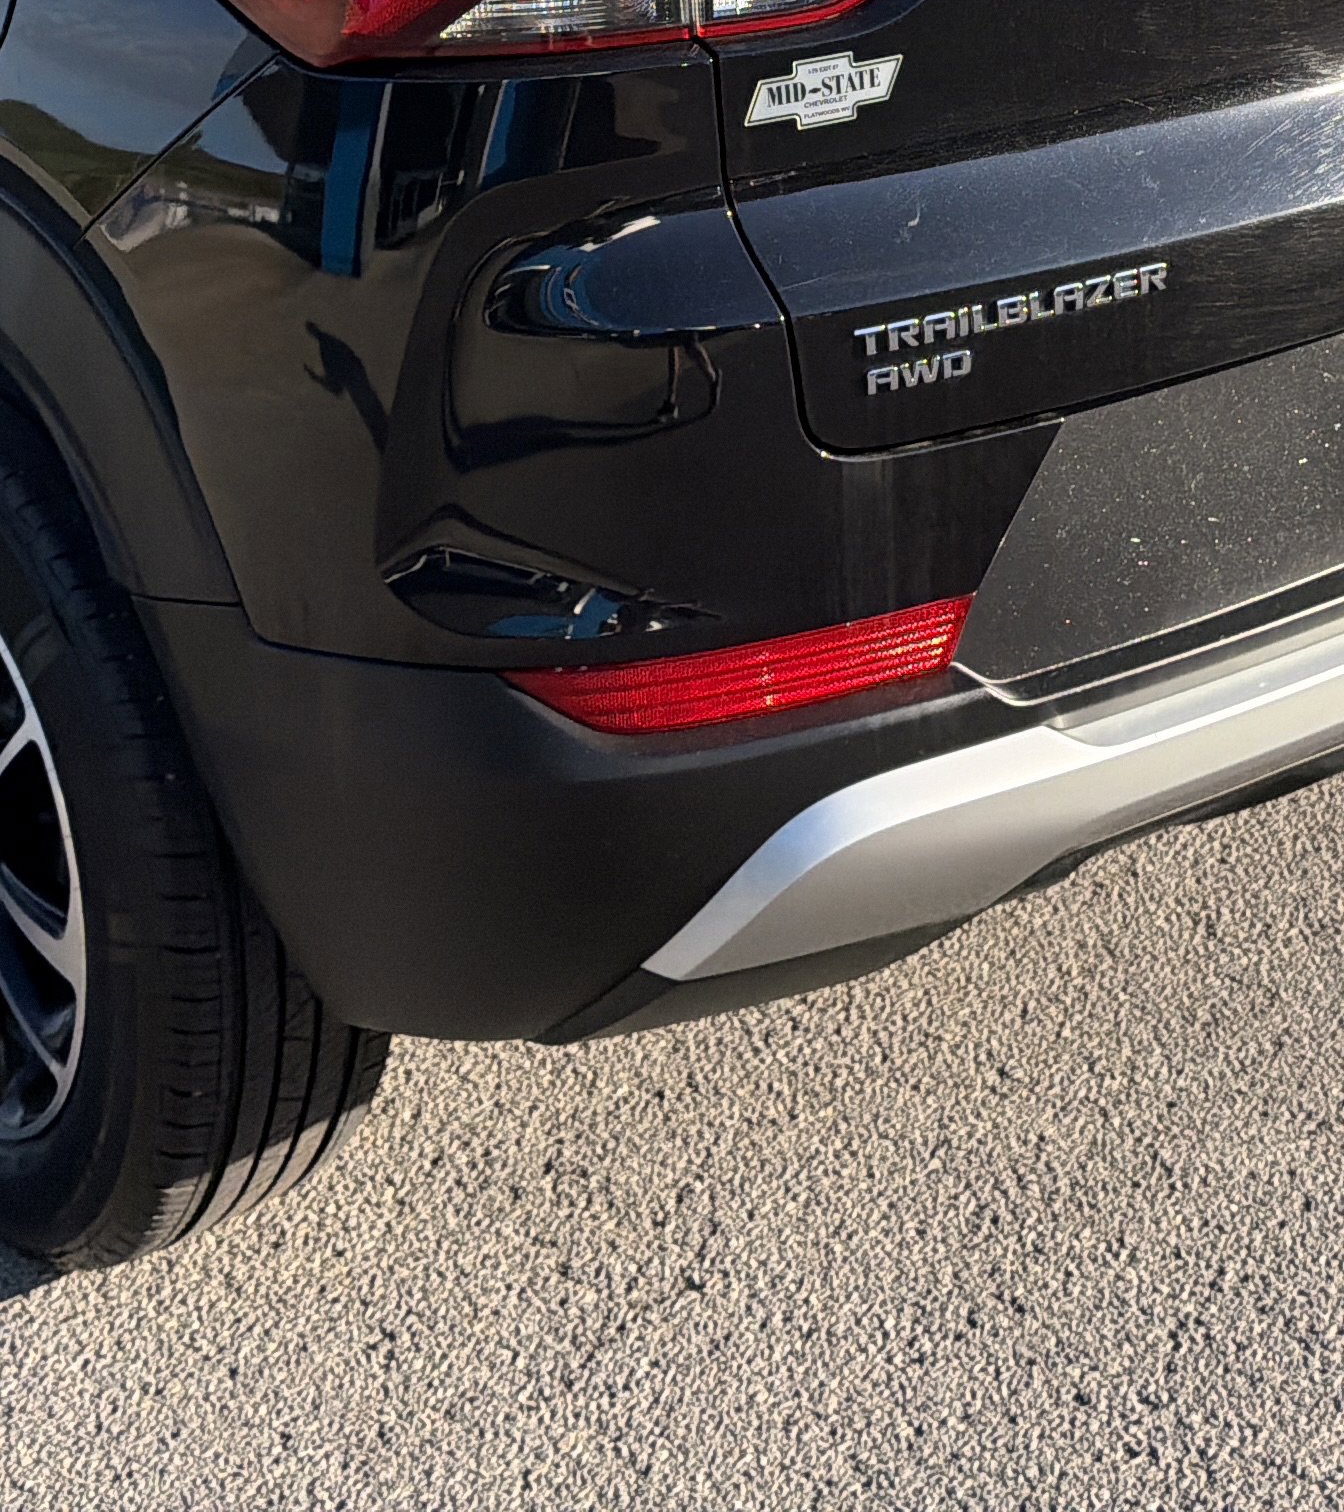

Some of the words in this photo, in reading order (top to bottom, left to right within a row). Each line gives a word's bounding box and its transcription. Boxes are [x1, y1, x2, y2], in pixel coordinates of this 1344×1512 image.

[803, 94, 848, 109] CHEVROLET
[803, 107, 840, 119] FLATWOODS
[854, 261, 1168, 356] TRAILBLAZER
[866, 349, 972, 395] AWD
